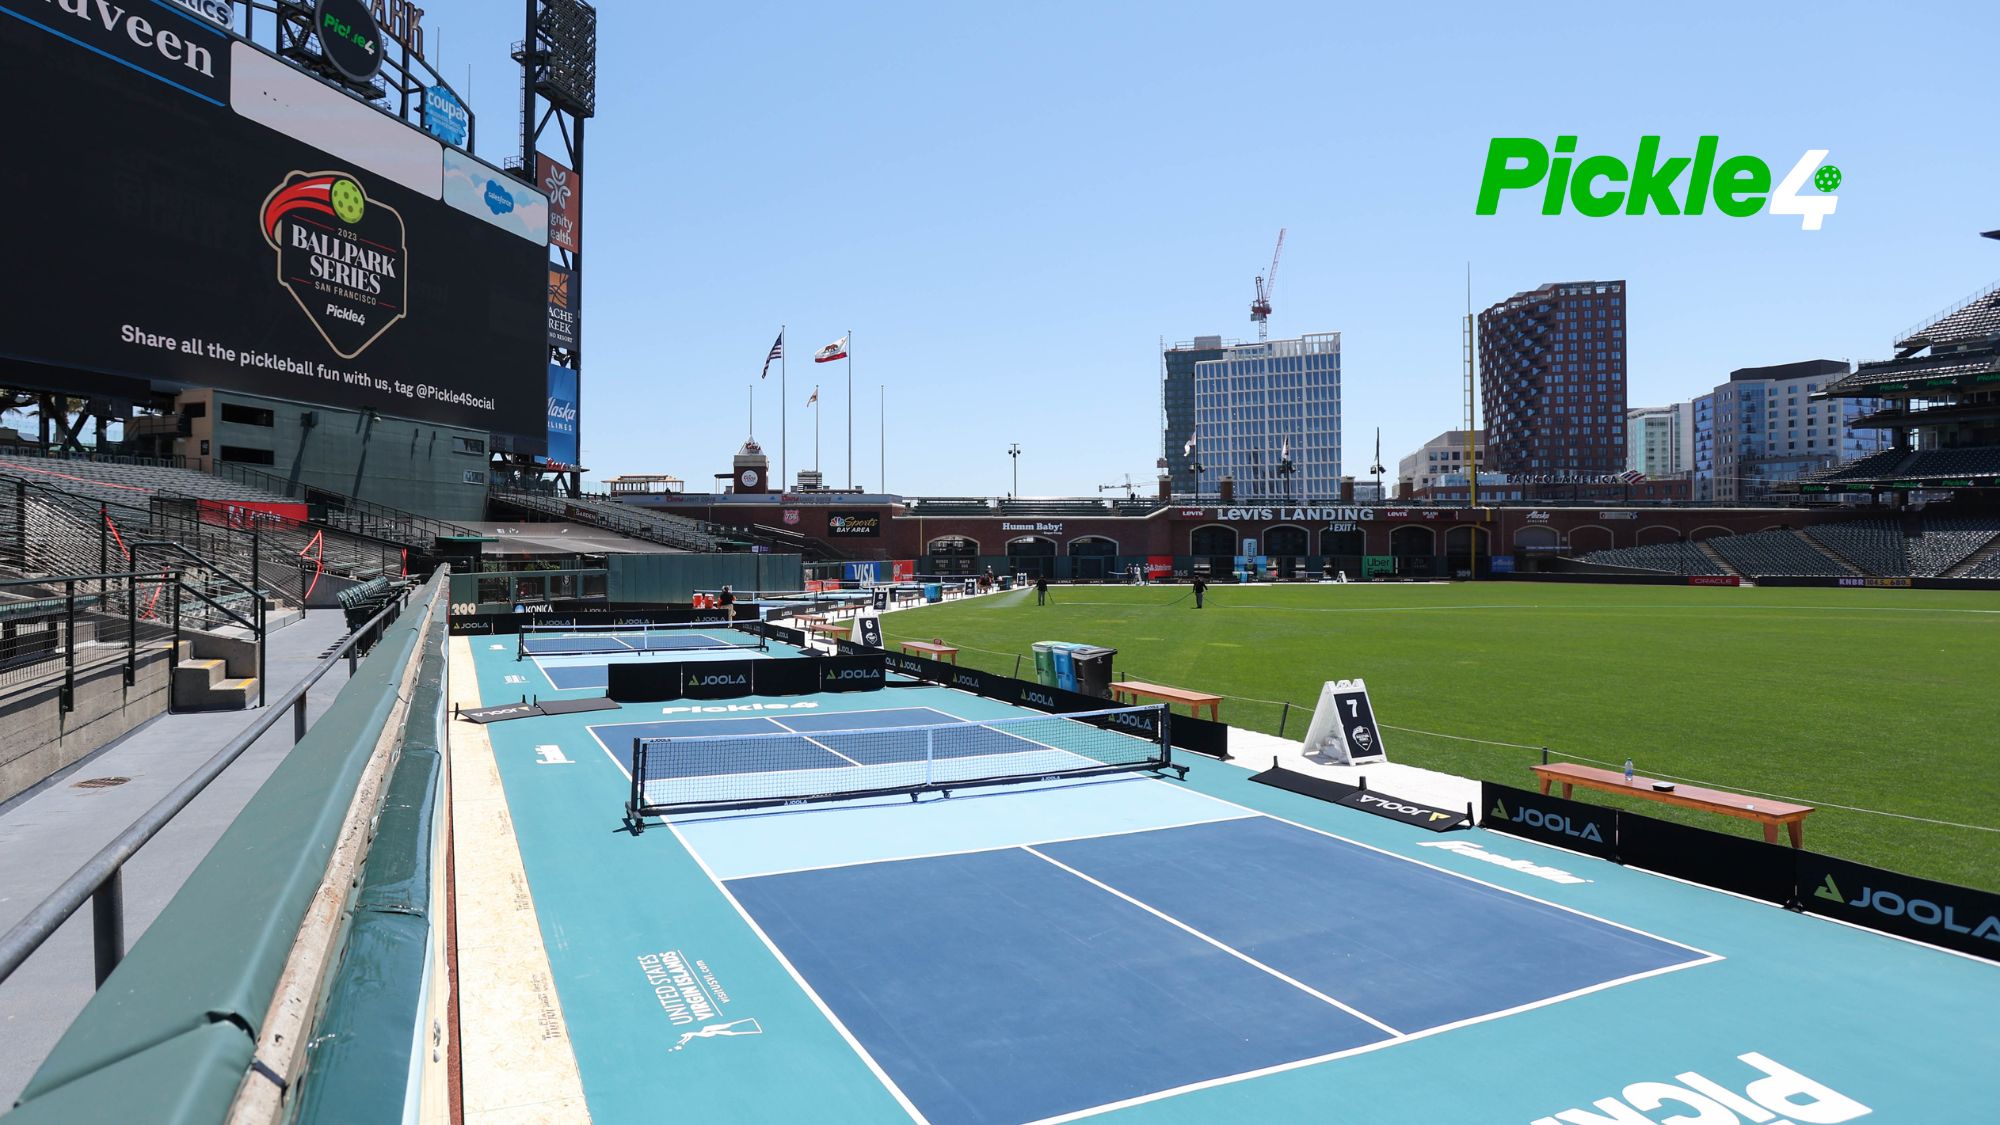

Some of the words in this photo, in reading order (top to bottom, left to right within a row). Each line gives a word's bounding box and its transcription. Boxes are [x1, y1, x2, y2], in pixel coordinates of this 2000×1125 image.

[370, 0, 424, 60] ARK
[45, 0, 214, 78] uveen
[428, 92, 463, 120] coupa
[488, 191, 512, 208] salesforce
[550, 212, 573, 231] gnity
[337, 227, 357, 241] 2023
[550, 229, 573, 246] ealth
[292, 223, 396, 279] BALLPARK
[310, 254, 381, 295] SERIES
[315, 281, 331, 293] SAN
[334, 285, 377, 306] FRANCISCO
[326, 303, 366, 326] Pickle4
[548, 307, 573, 323] ACHE
[548, 318, 572, 335] REEK
[121, 324, 177, 350] Share
[181, 338, 203, 356] all
[207, 342, 236, 361] the
[240, 350, 314, 377] pickleball
[317, 363, 340, 382] fun
[343, 371, 371, 387] with
[375, 377, 392, 394] us,
[394, 379, 414, 398] tag
[416, 383, 495, 411] @Pickle4Social
[548, 421, 572, 432] LINES
[1506, 474, 1538, 484] BANK
[1561, 474, 1618, 484] AMERICA
[844, 516, 878, 528] Sports
[1281, 508, 1374, 521] LANDING
[1002, 522, 1035, 530] Humm
[1036, 522, 1063, 532] Baby!
[1334, 523, 1351, 531] EXIT
[1367, 558, 1390, 566] Uber
[852, 563, 875, 587] VISA
[1840, 578, 1864, 586] KNBR
[865, 620, 873, 629] 6
[885, 657, 896, 667] OLA
[903, 661, 922, 673] JOOLA
[701, 674, 747, 686] JOOLA
[837, 668, 880, 679] JOOLA
[957, 675, 979, 688] JOOLA
[1026, 691, 1055, 707] JOOLA
[471, 707, 518, 717] JOOLA
[1346, 699, 1358, 717] 7
[1115, 713, 1152, 731] JOOLA
[1359, 794, 1430, 816] JOOLA
[1511, 805, 1604, 844] JOOLA
[1849, 887, 2000, 943] JOOLA
[637, 954, 672, 985] STATES
[659, 951, 694, 986] ISLANDS
[655, 985, 693, 1025] UNITED
[680, 985, 714, 1021] VIRGIN
